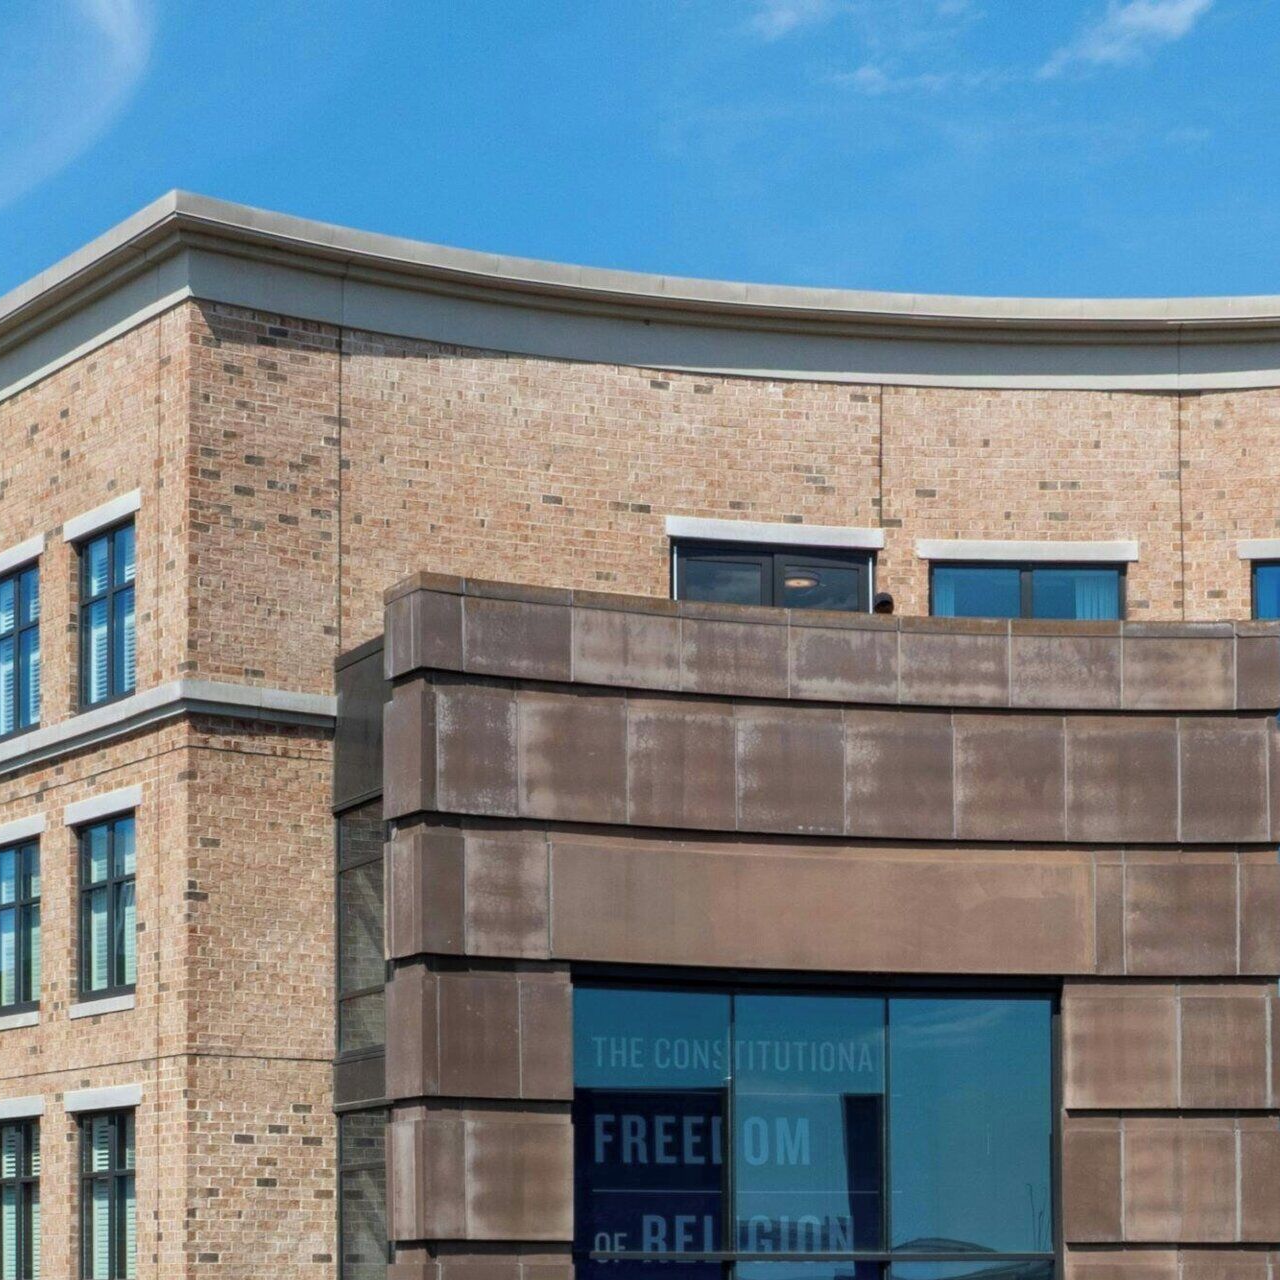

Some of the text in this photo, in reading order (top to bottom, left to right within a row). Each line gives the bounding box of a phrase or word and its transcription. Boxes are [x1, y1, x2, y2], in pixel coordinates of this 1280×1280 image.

[591, 1036, 874, 1072] THE CONSTITUTIONA
[594, 1232, 628, 1264] OF
